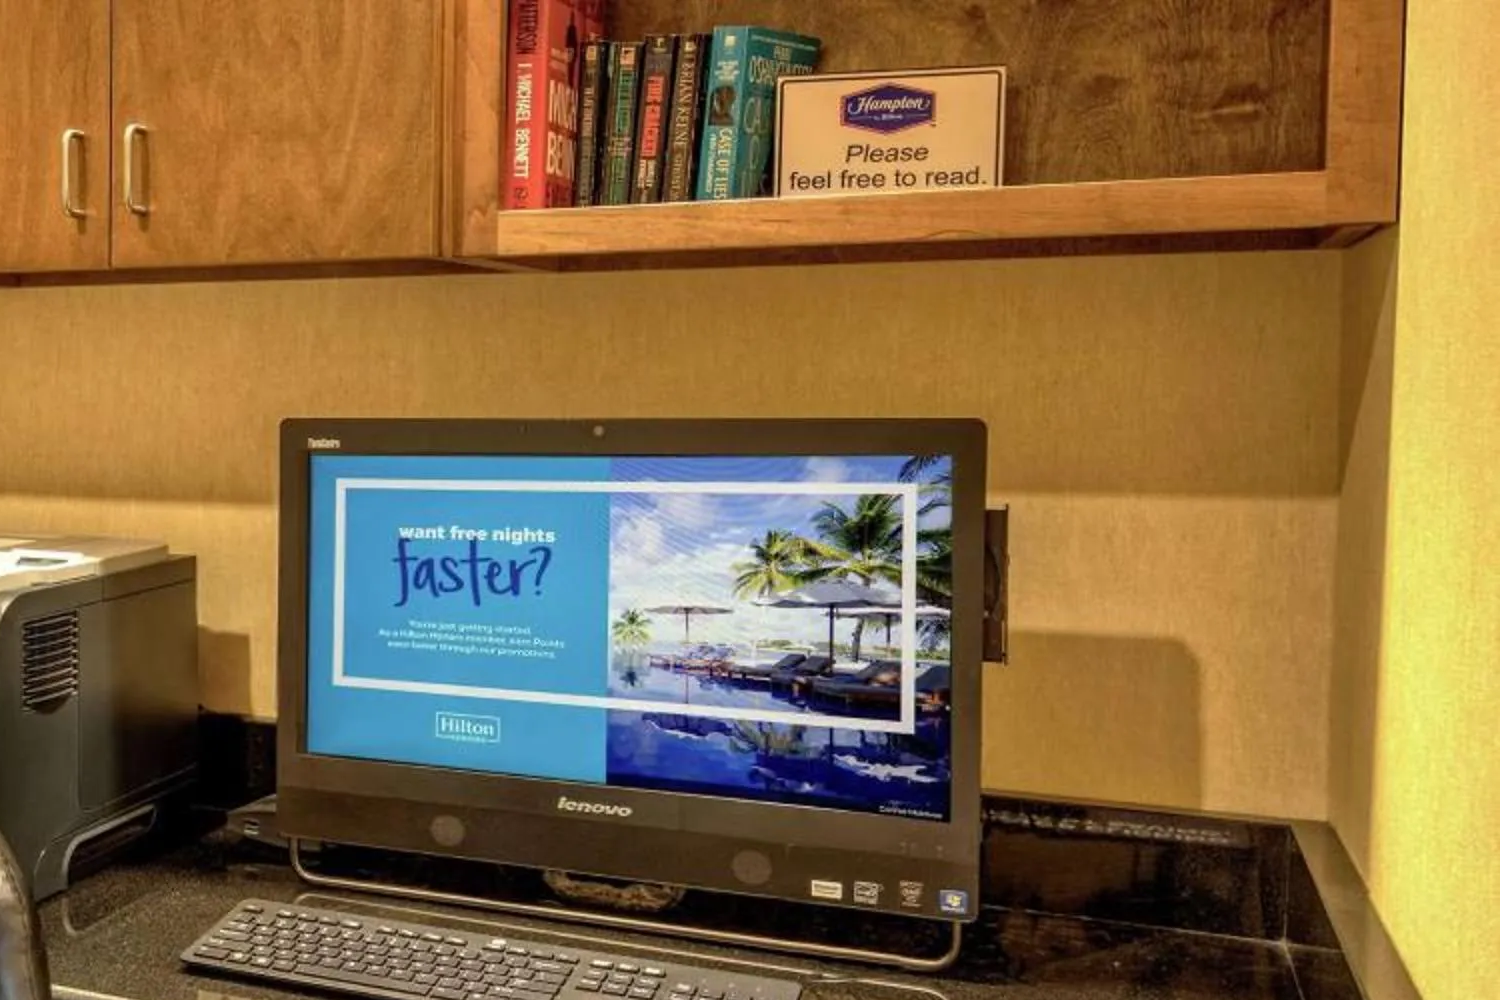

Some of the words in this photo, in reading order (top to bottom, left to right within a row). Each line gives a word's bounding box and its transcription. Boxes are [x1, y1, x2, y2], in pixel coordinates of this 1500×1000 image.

[515, 74, 533, 124] MICHAEL
[847, 95, 931, 115] Hampton
[717, 127, 733, 156] CASE
[513, 129, 531, 178] BENNETT
[845, 143, 930, 164] Please
[789, 170, 832, 190] feel
[840, 168, 886, 189] free
[895, 169, 917, 188] to
[925, 165, 987, 187] read.
[398, 526, 447, 539] want
[450, 525, 488, 541] free
[492, 526, 556, 545] nights
[392, 537, 553, 608] faster?
[440, 716, 495, 737] Hilton
[557, 796, 634, 817] lenovo
